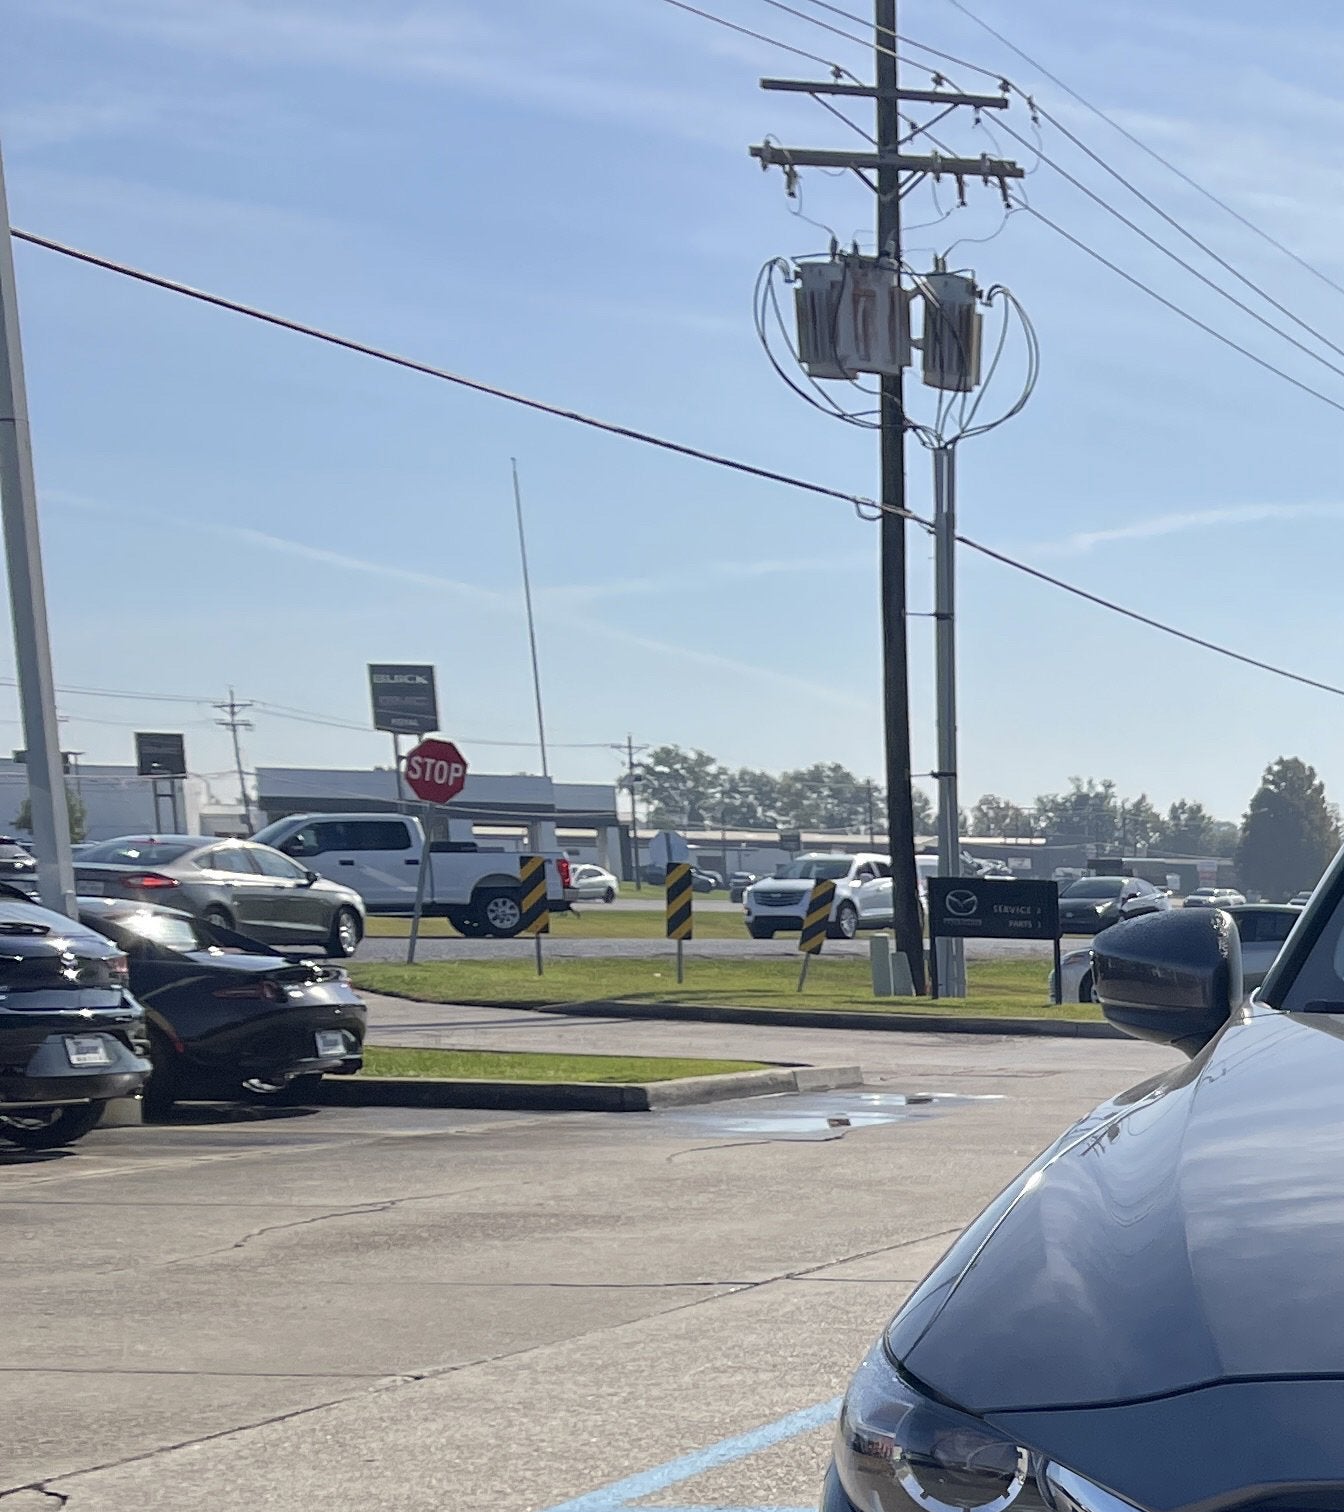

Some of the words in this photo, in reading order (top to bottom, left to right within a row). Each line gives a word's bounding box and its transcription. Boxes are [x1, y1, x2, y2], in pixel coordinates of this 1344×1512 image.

[408, 755, 463, 786] STOP
[993, 904, 1031, 914] SERVICE
[1009, 920, 1032, 929] PARTS
